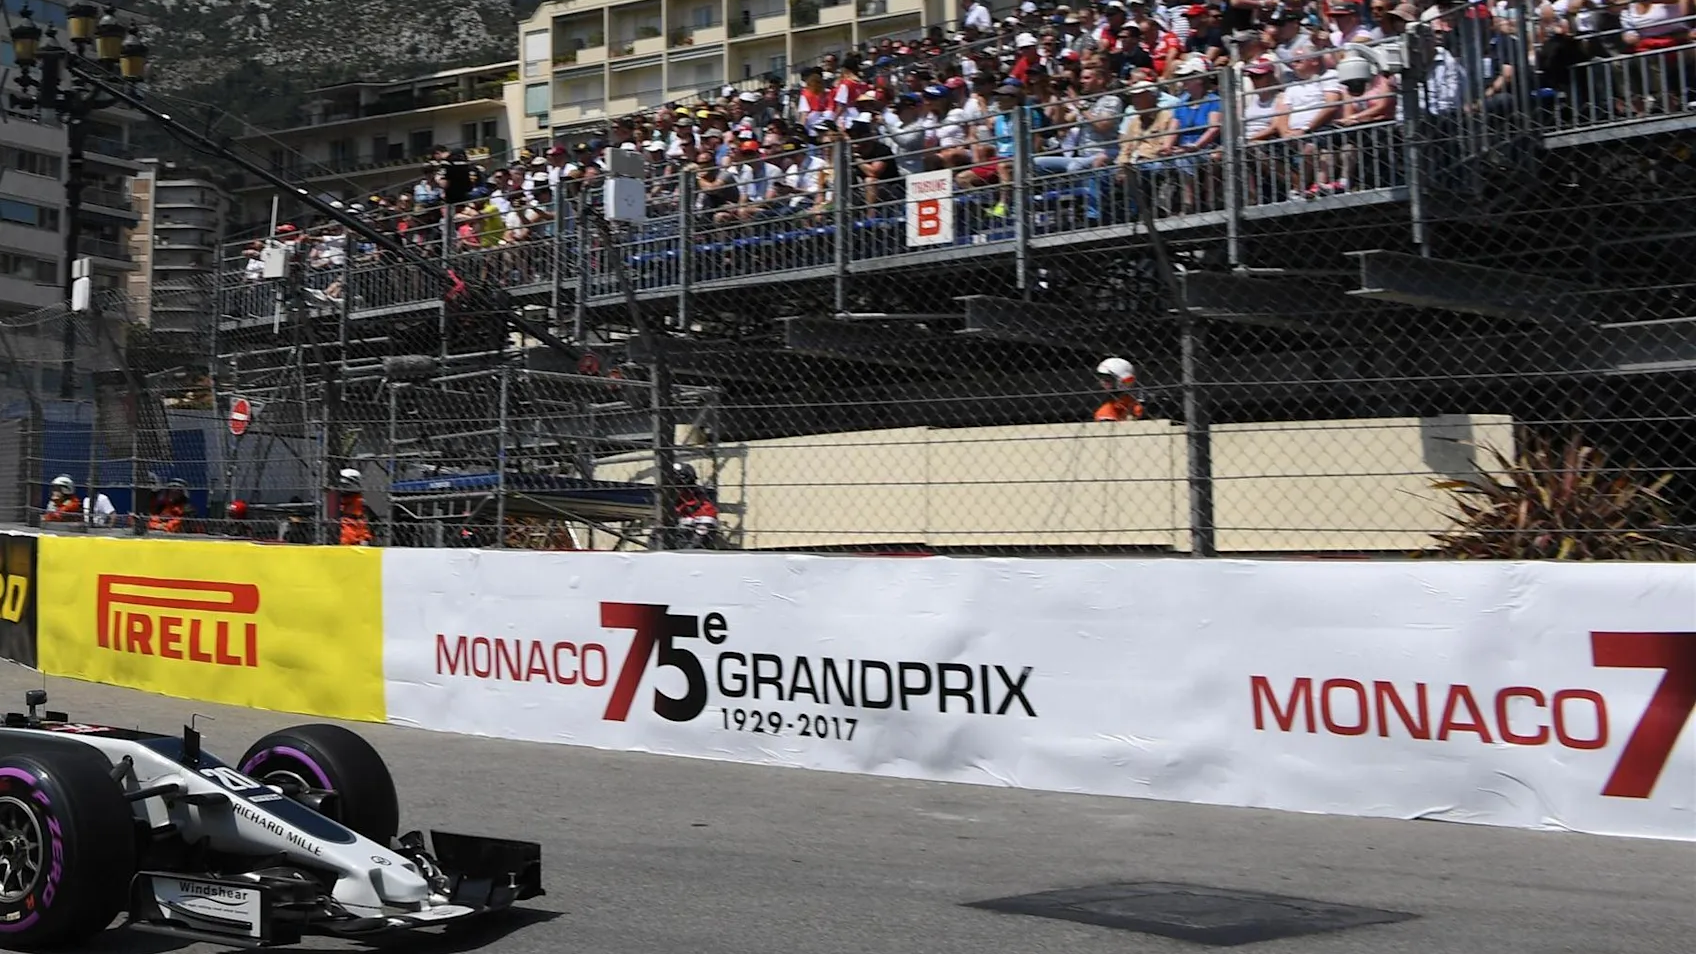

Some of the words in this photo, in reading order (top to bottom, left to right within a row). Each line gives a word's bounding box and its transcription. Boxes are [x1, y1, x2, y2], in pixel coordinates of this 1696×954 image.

[917, 199, 940, 237] B
[97, 573, 260, 668] PIRELLI
[435, 632, 605, 689] MONACO
[715, 649, 1038, 719] GRANDPRIX
[719, 707, 859, 743] 1929-2017
[1249, 673, 1608, 752] MONACO
[199, 766, 262, 791] 20
[232, 802, 285, 837] RICHARD
[285, 831, 324, 858] MILLE
[42, 814, 64, 909] ZERO
[178, 881, 250, 901] Windshear
